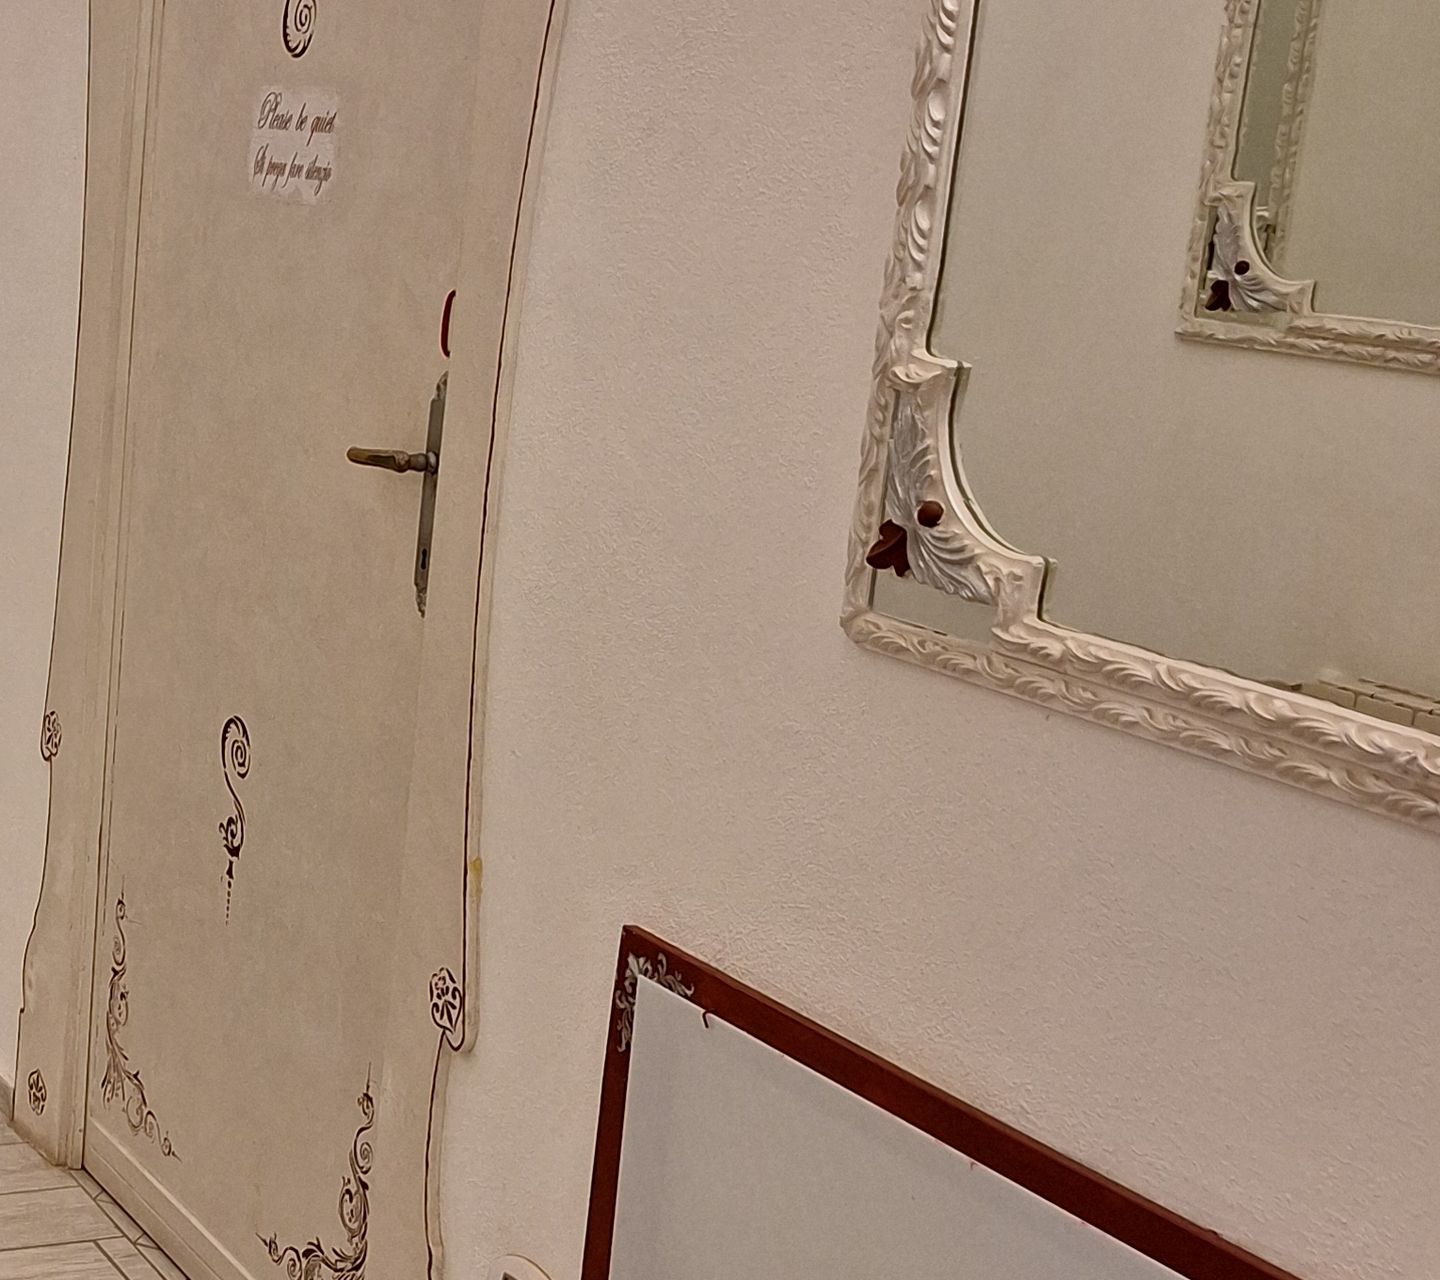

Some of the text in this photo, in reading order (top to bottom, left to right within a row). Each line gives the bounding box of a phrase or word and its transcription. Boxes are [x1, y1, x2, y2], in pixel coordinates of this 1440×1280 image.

[257, 91, 337, 147] Please be quiet
